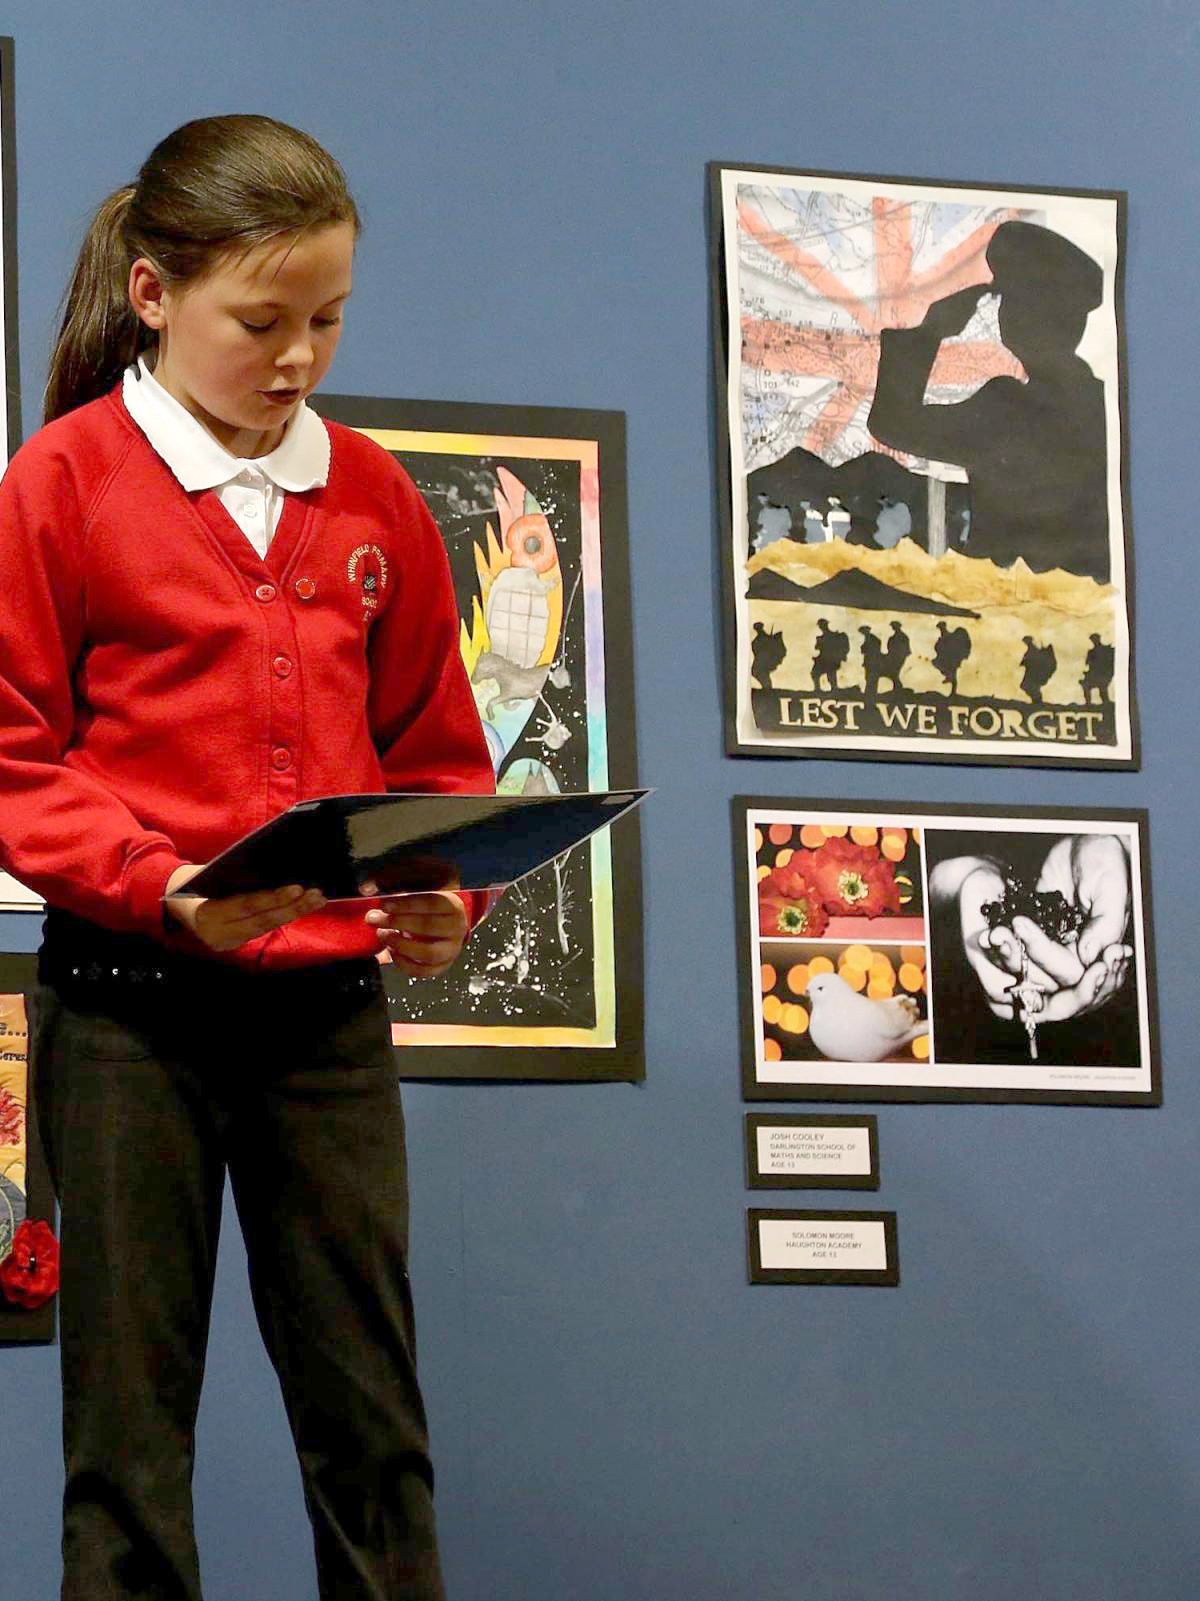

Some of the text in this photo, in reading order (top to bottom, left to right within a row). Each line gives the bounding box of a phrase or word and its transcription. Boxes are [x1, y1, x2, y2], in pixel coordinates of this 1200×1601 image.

[779, 697, 1104, 741] LEST WE FORGET
[770, 1133, 825, 1141] JOSH COOLEY
[786, 1241, 827, 1249] HAUGHTON
